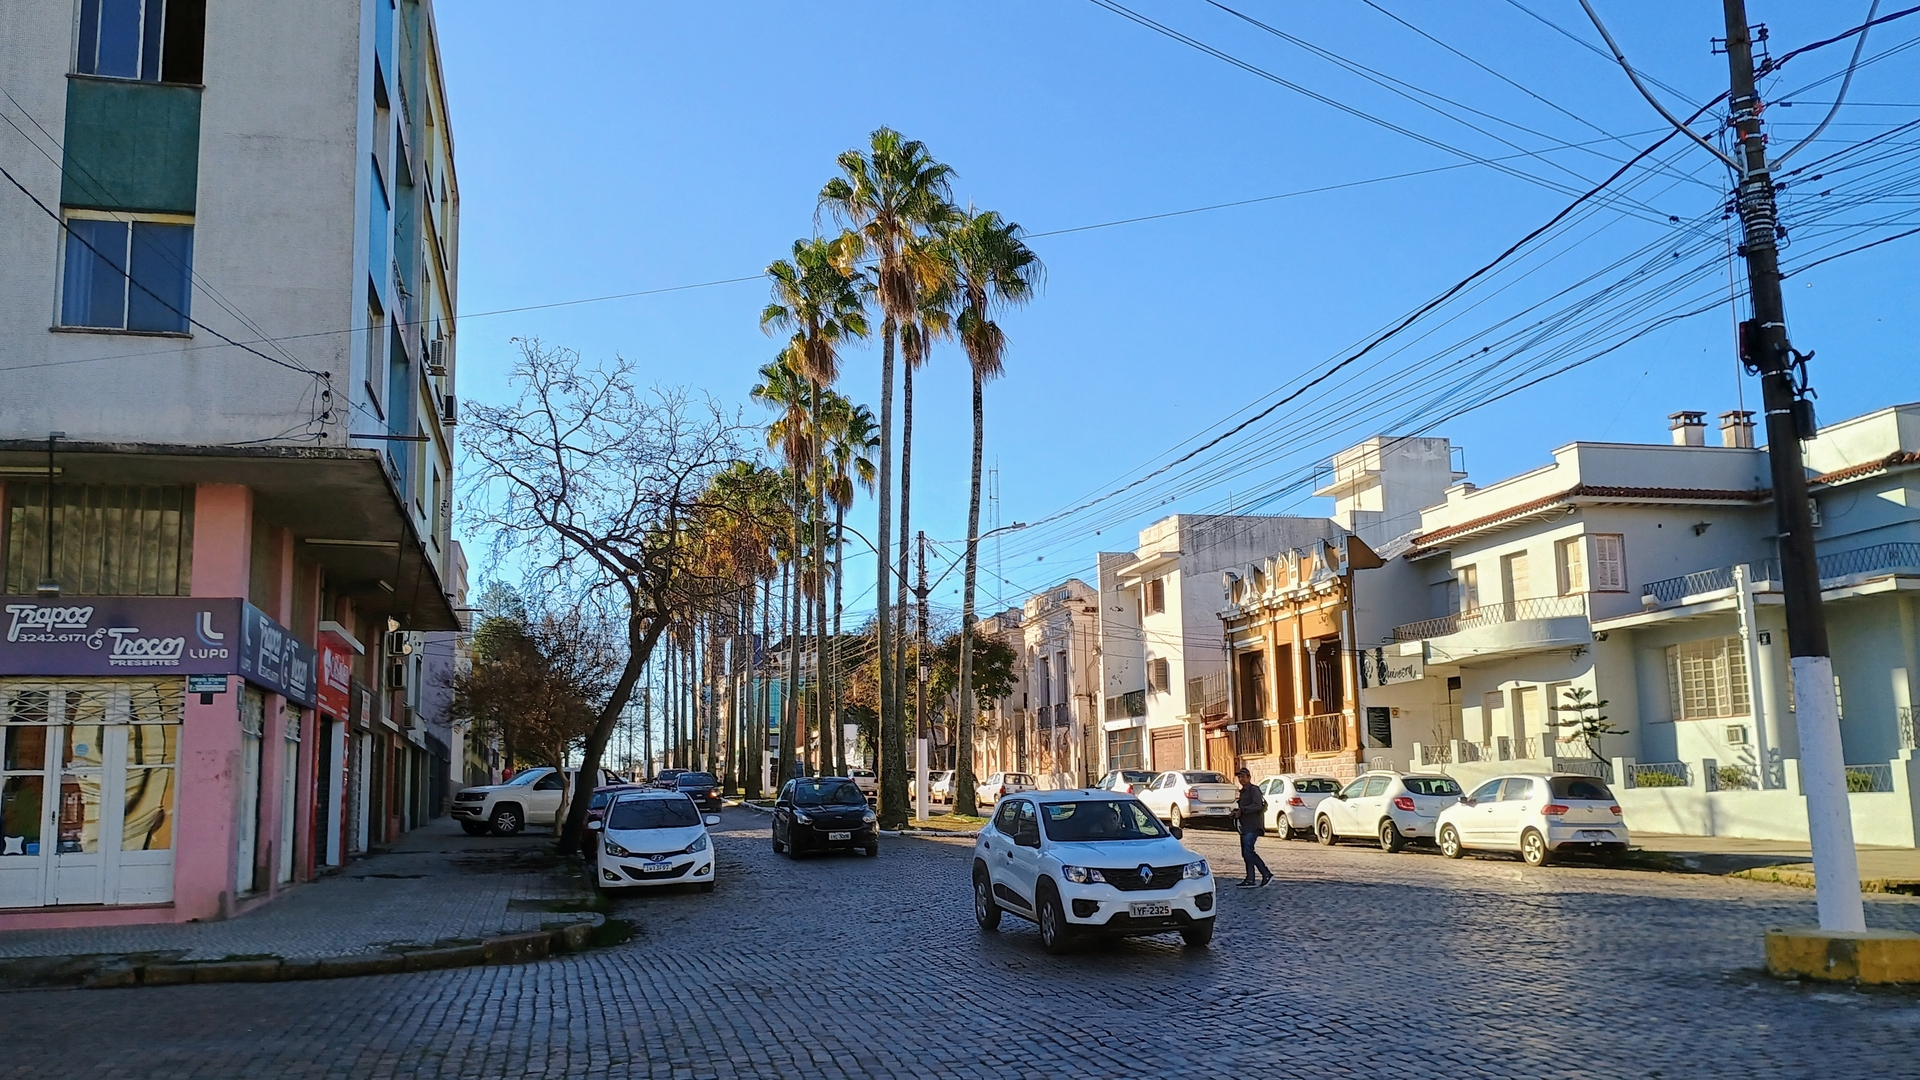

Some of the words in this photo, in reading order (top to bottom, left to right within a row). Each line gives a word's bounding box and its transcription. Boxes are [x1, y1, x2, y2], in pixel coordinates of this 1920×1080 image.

[6, 604, 94, 642] Trapos
[108, 627, 185, 660] Trocos
[19, 633, 87, 642] 3242.6171
[189, 648, 229, 659] LUPO
[109, 659, 180, 667] PRESENTES
[1133, 905, 1170, 916] IYF-2325
